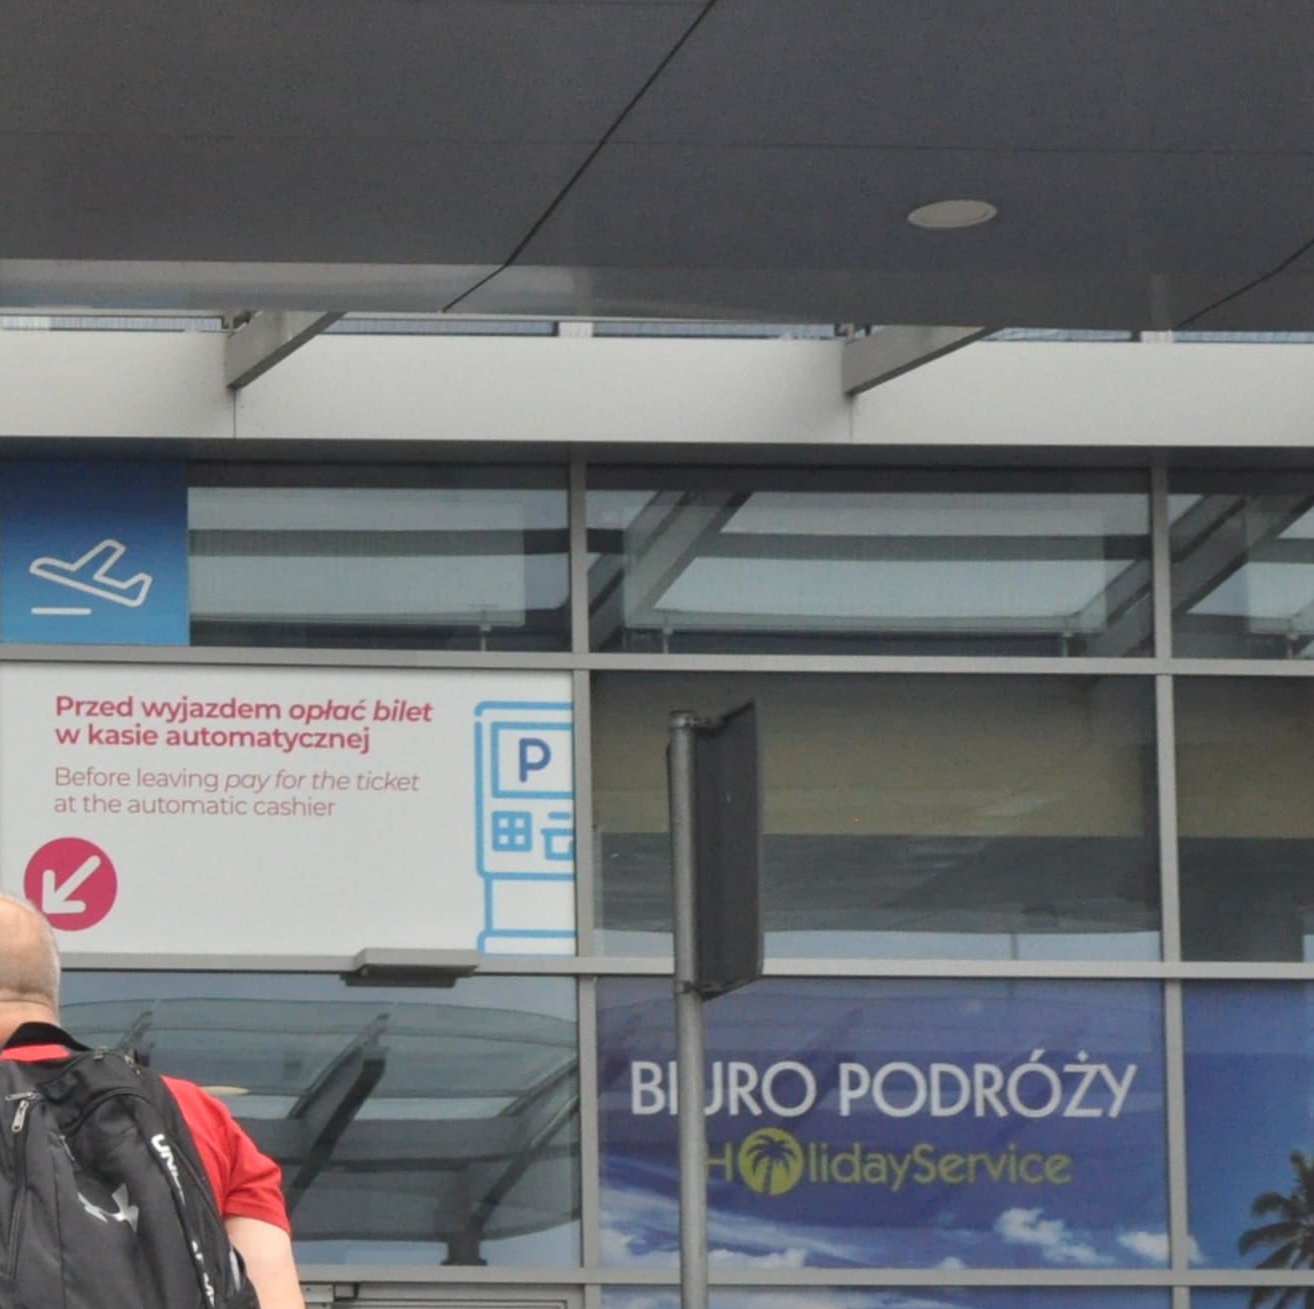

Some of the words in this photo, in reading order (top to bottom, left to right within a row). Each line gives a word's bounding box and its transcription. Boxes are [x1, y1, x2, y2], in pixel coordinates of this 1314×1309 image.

[55, 695, 134, 718] Przed
[140, 698, 282, 725] wyjazdem
[287, 699, 367, 726] opłać
[372, 699, 434, 723] bilet
[55, 728, 81, 746] w
[87, 723, 160, 747] kasie
[165, 727, 371, 755] automatycznej
[54, 767, 131, 787] Before
[137, 768, 219, 793] leaving
[224, 774, 271, 794] pay
[275, 770, 307, 790] for
[312, 771, 350, 791] the
[356, 772, 420, 792] ticket
[54, 796, 77, 814] at
[82, 795, 122, 814] the
[127, 796, 246, 816] automatic
[253, 798, 335, 817] cashier
[839, 1049, 1138, 1119] PODRÓŻY
